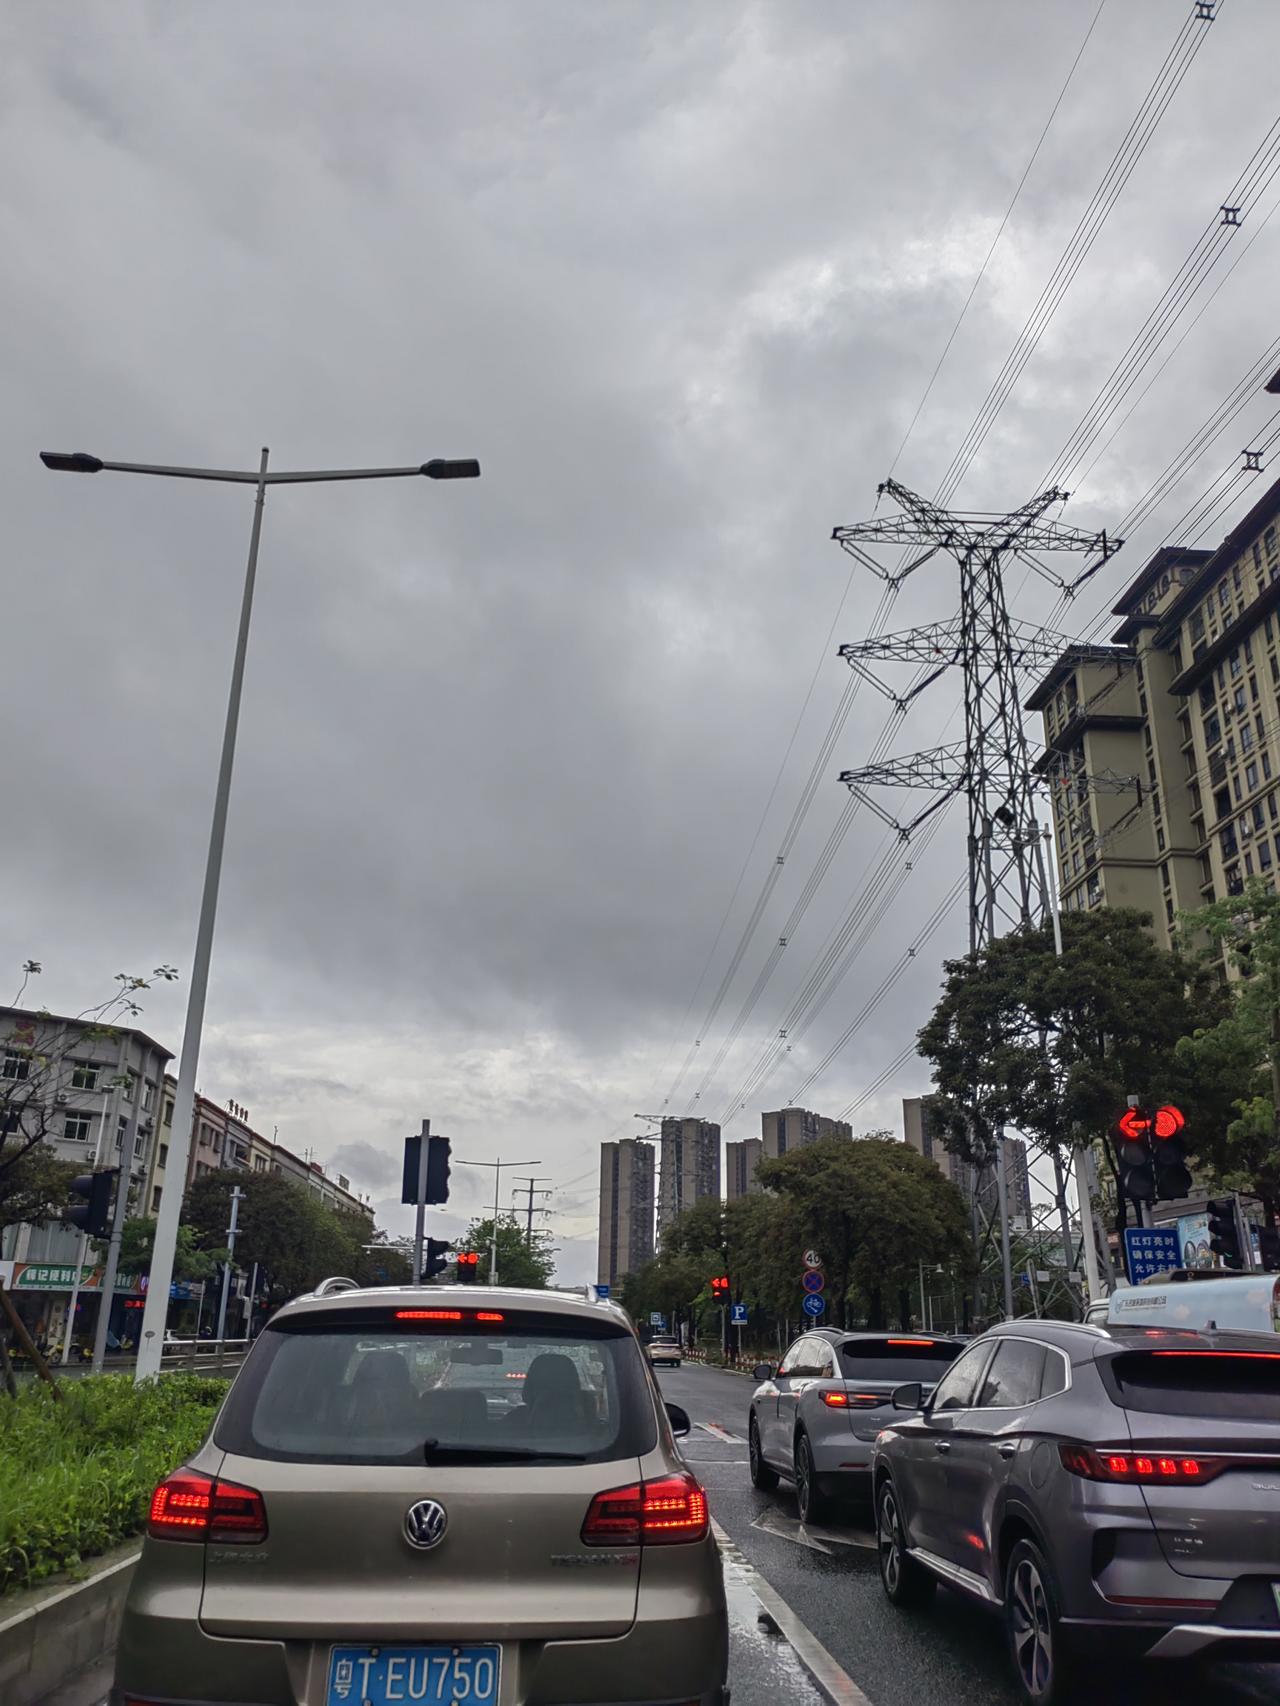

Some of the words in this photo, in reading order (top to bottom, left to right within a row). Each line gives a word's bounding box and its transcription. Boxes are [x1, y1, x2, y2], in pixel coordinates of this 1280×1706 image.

[1131, 1236, 1174, 1246] 红灯亮时
[806, 1251, 820, 1265] 40
[1132, 1250, 1176, 1260] 确保安全
[734, 1306, 745, 1319] P
